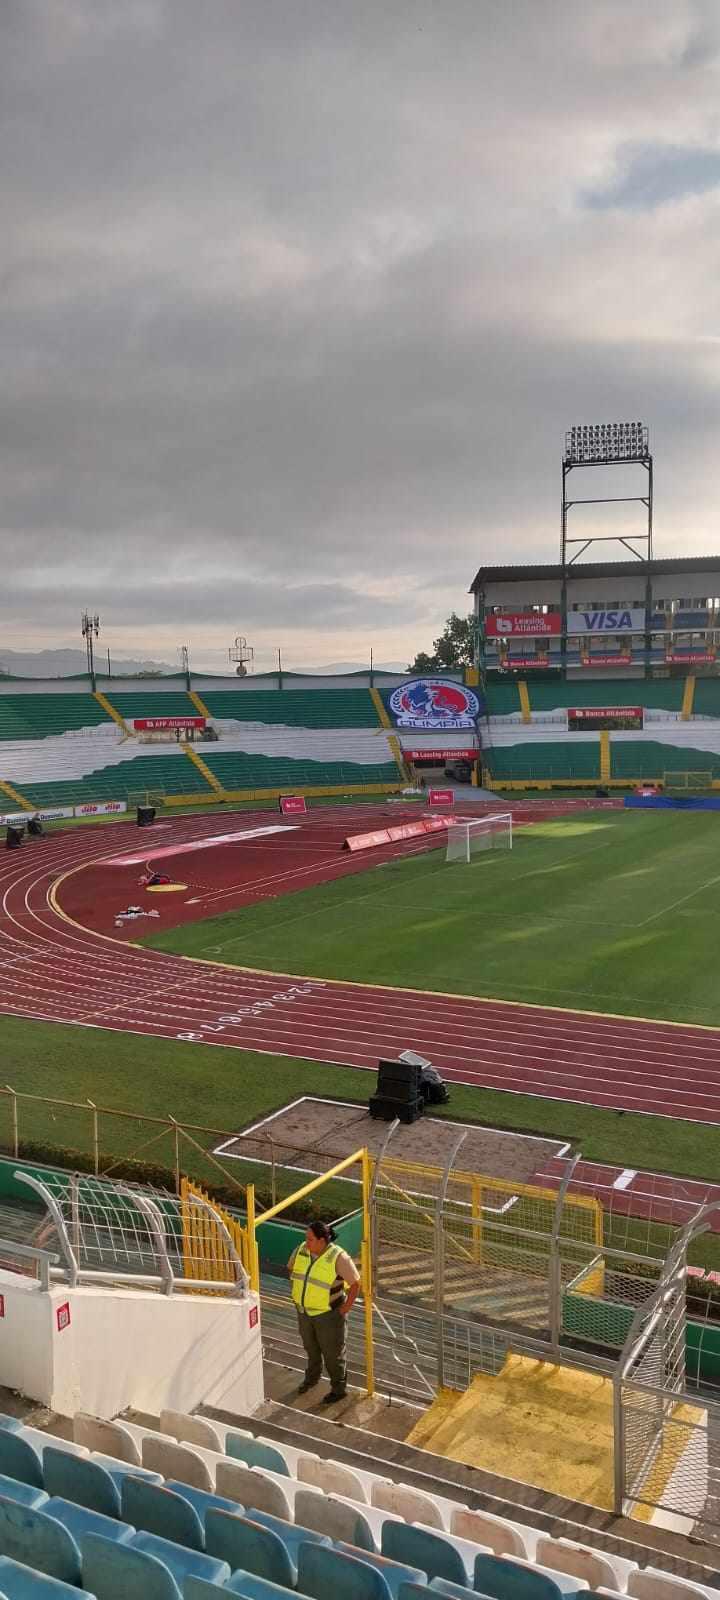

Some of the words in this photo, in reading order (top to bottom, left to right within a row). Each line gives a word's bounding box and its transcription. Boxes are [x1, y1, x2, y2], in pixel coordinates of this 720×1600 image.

[514, 616, 545, 626] Leasing
[581, 611, 633, 630] VISA
[399, 719, 473, 728] OLIMPIA
[272, 993, 296, 1001] 3
[252, 1000, 276, 1008] 4
[237, 1007, 263, 1015] 5
[200, 1023, 226, 1032] 7
[176, 1032, 204, 1040] 8
